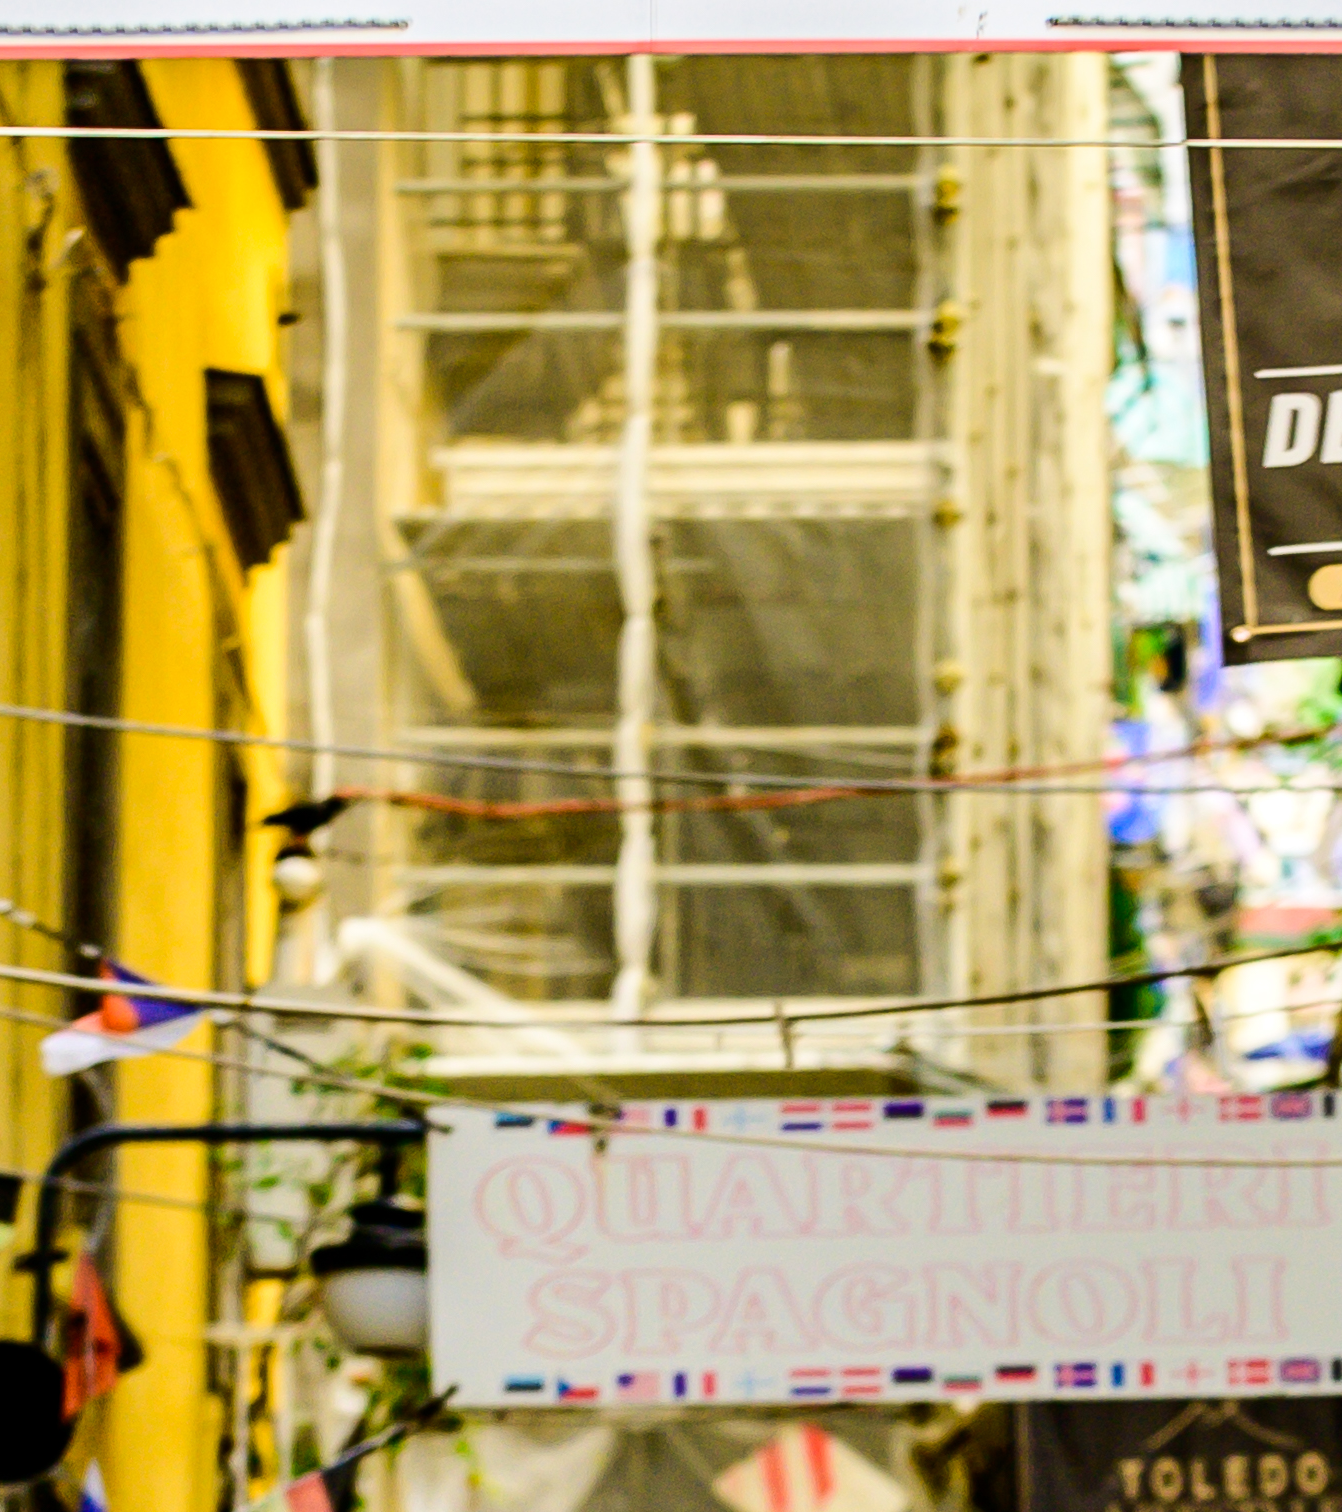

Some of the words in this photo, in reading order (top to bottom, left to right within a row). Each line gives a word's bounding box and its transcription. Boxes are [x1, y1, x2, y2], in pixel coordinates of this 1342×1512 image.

[474, 1138, 1333, 1263] QUARTIERI
[524, 1253, 1289, 1360] SPAGNOLI
[1117, 1449, 1331, 1503] TOLEDO
